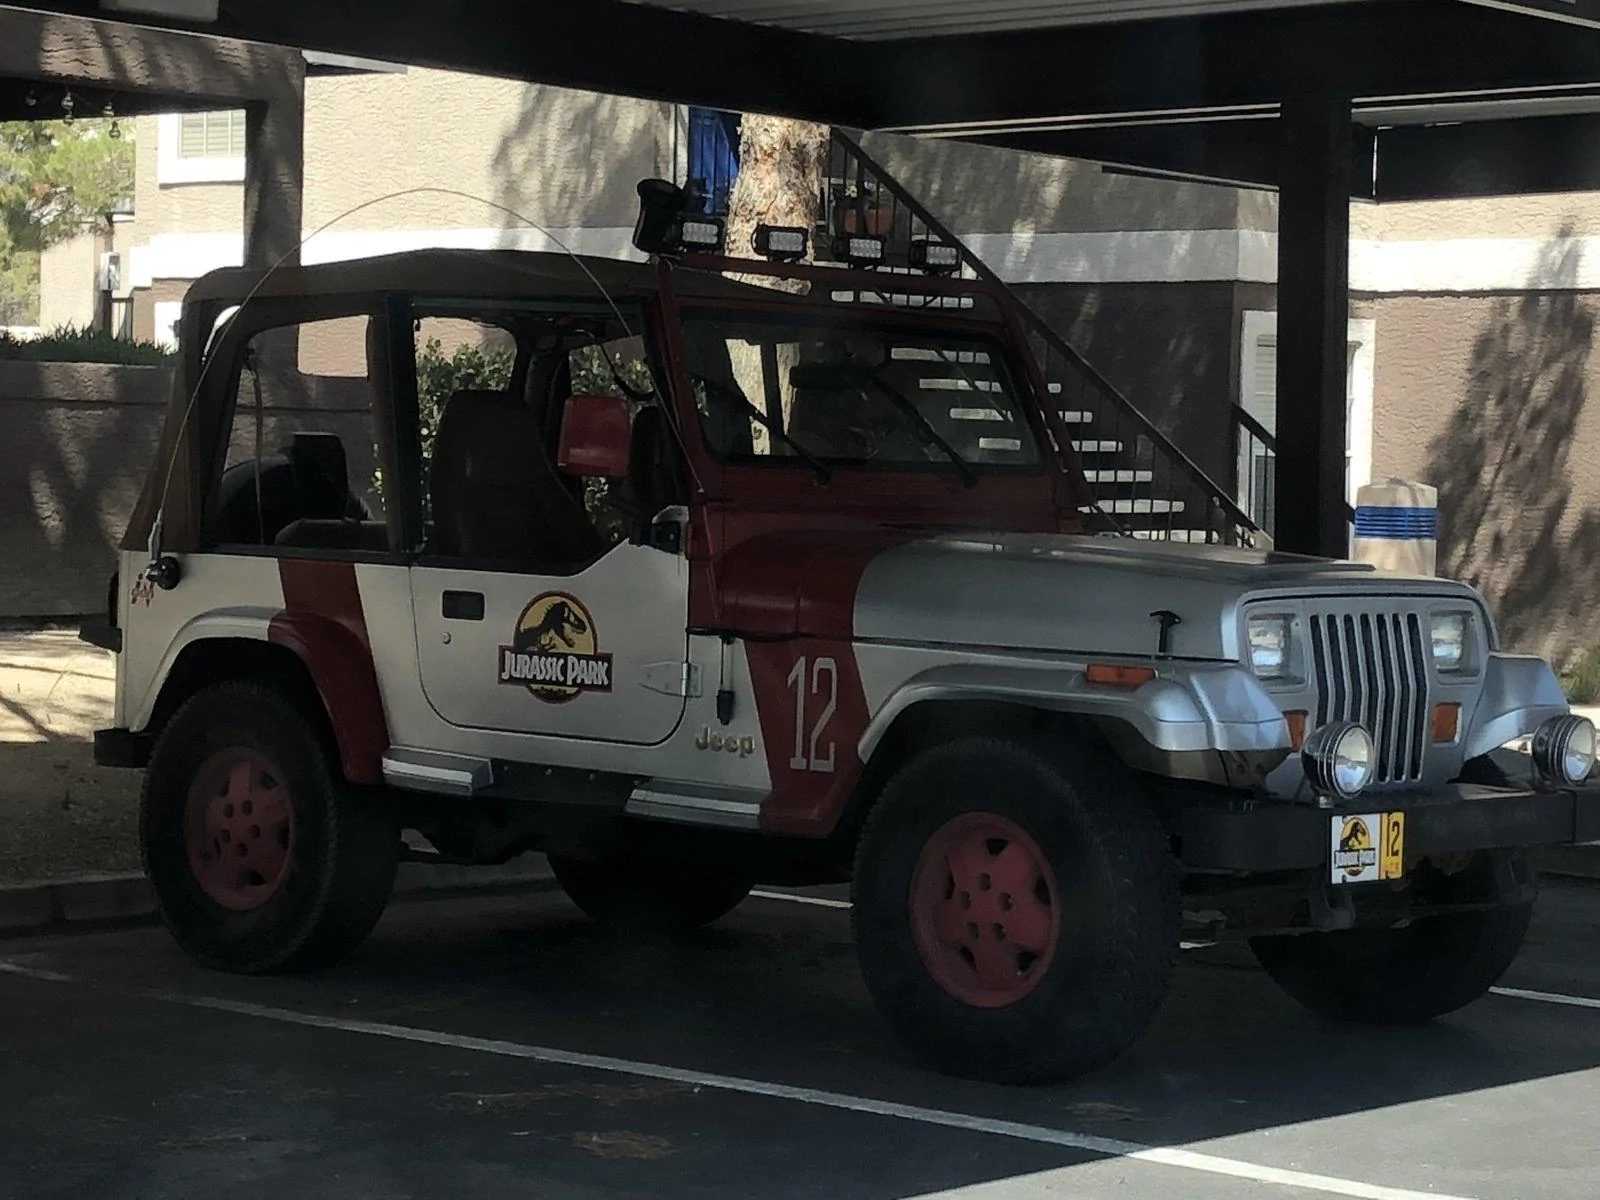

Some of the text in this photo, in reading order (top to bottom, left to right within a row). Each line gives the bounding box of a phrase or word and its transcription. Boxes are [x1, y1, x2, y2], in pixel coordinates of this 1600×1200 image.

[501, 650, 609, 686] JURASSIC PARK
[787, 656, 837, 772] 12
[696, 726, 755, 758] Jeep
[1386, 817, 1400, 857] 12
